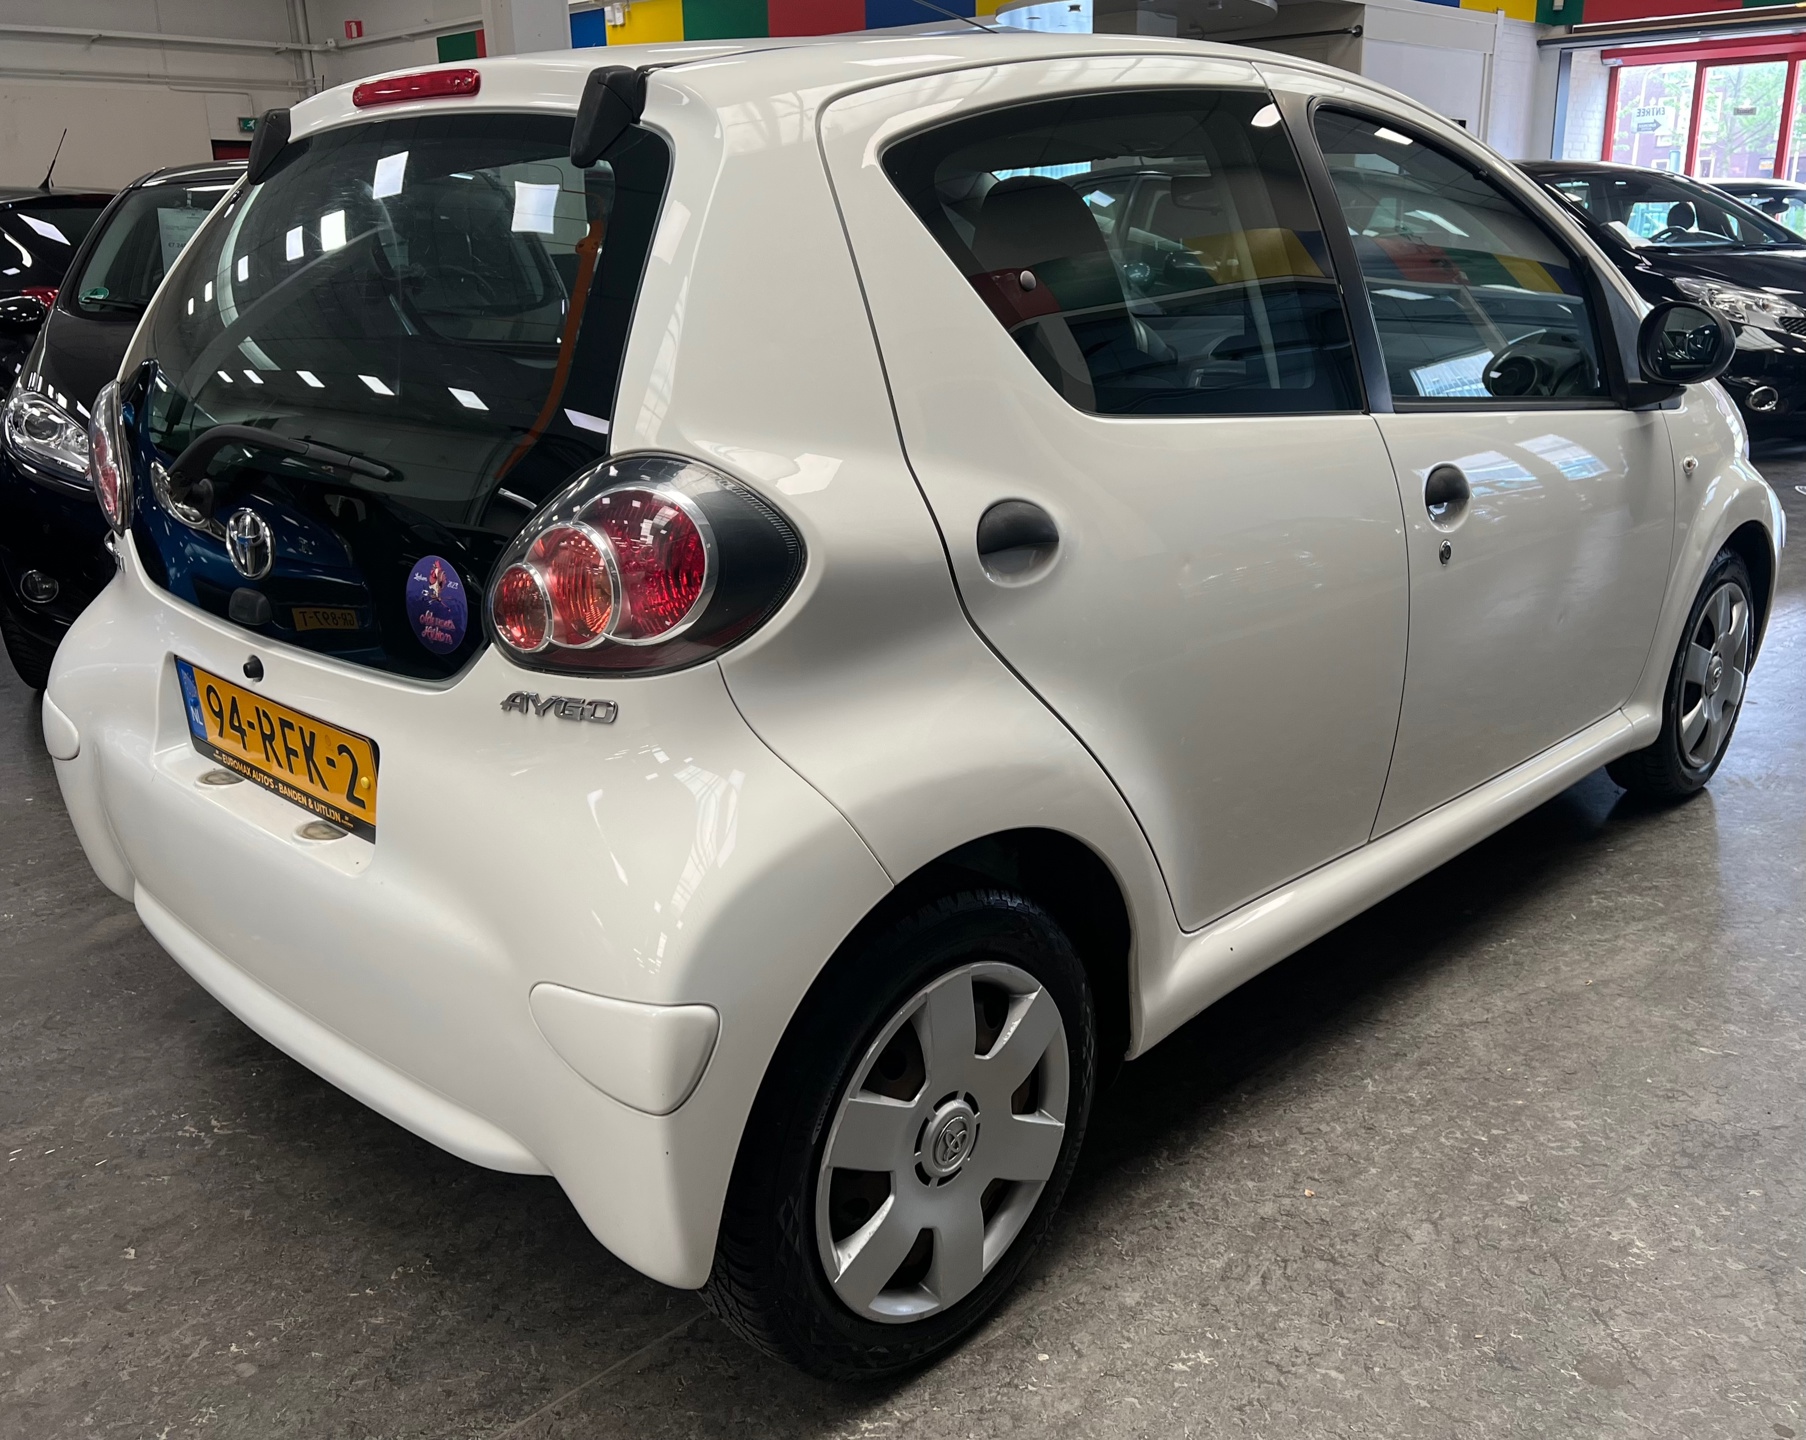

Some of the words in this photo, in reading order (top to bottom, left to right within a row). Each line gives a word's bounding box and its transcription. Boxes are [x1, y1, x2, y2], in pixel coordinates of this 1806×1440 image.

[190, 706, 203, 726] NL
[500, 690, 619, 724] AYGO
[206, 684, 367, 810] 94-RFK-2
[222, 753, 252, 778] EUROMAX
[252, 769, 275, 789] AUTO'S
[278, 782, 308, 806] BANDEN
[308, 798, 314, 809] &
